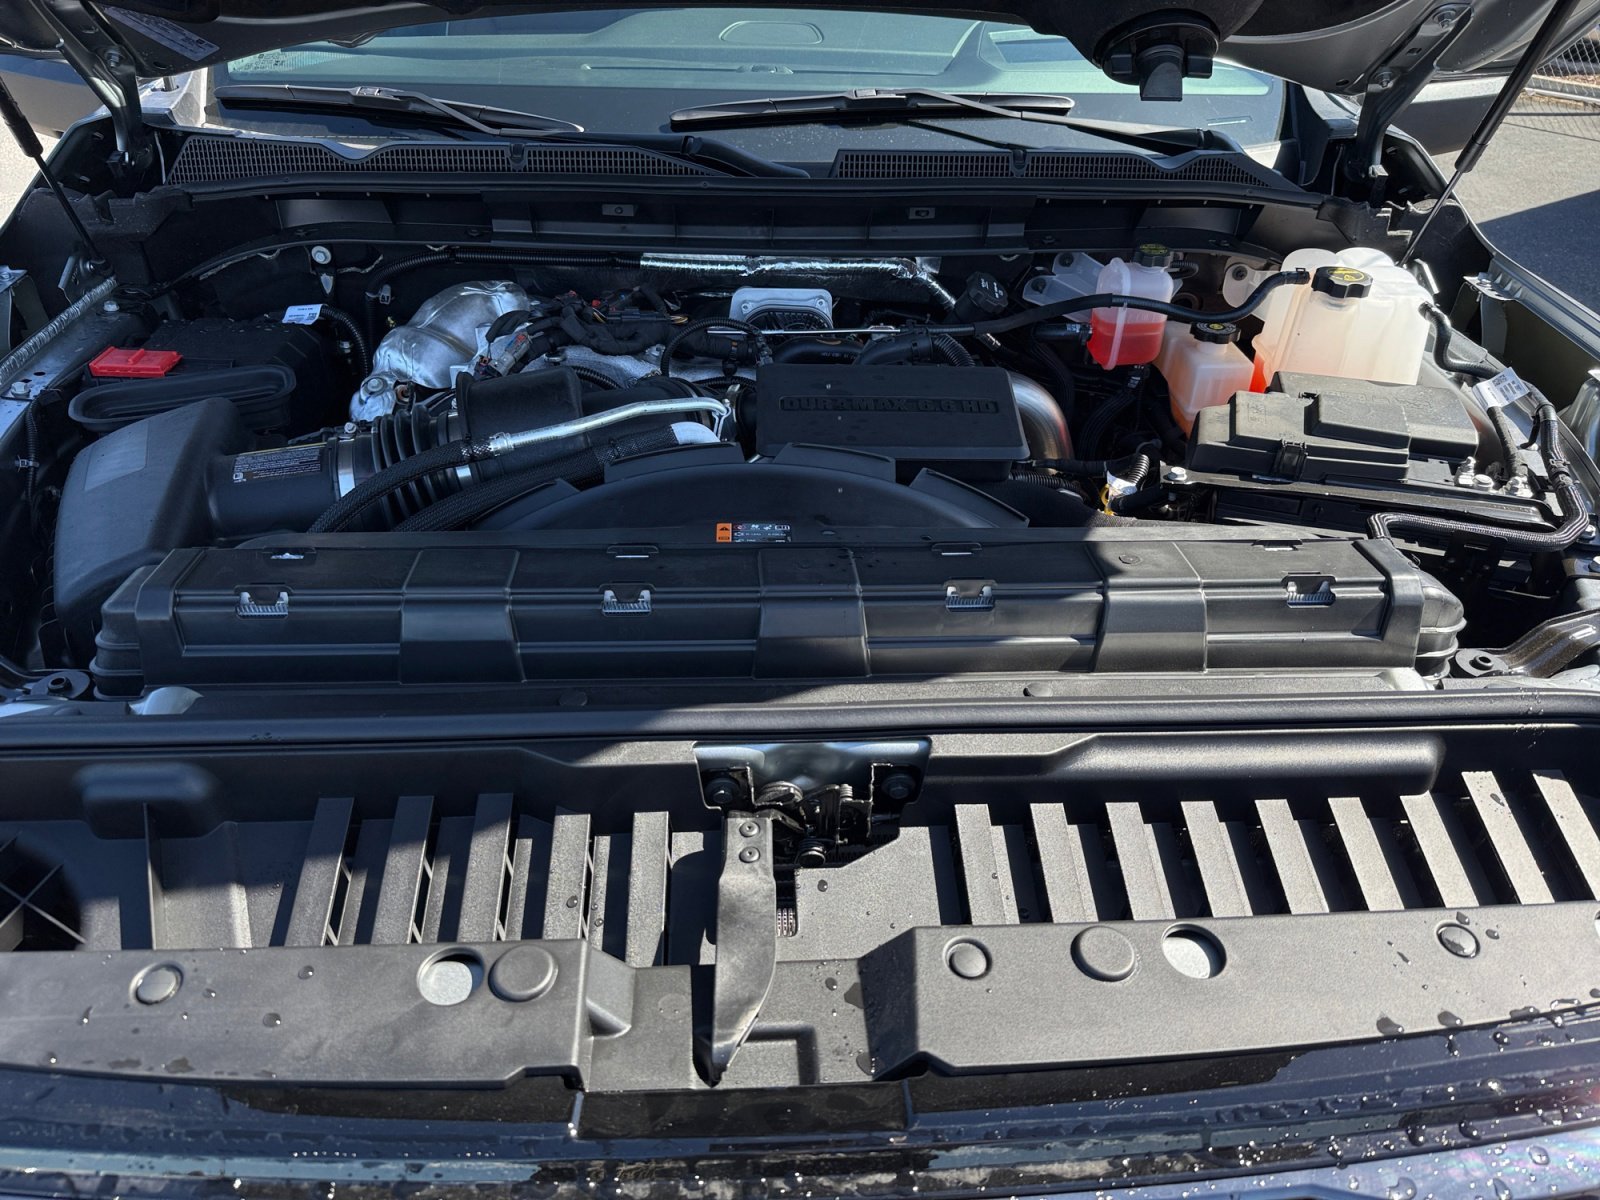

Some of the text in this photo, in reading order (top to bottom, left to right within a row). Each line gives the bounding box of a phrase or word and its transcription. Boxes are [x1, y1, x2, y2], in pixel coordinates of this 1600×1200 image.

[783, 397, 996, 413] DURAMAX 6.6 HD
